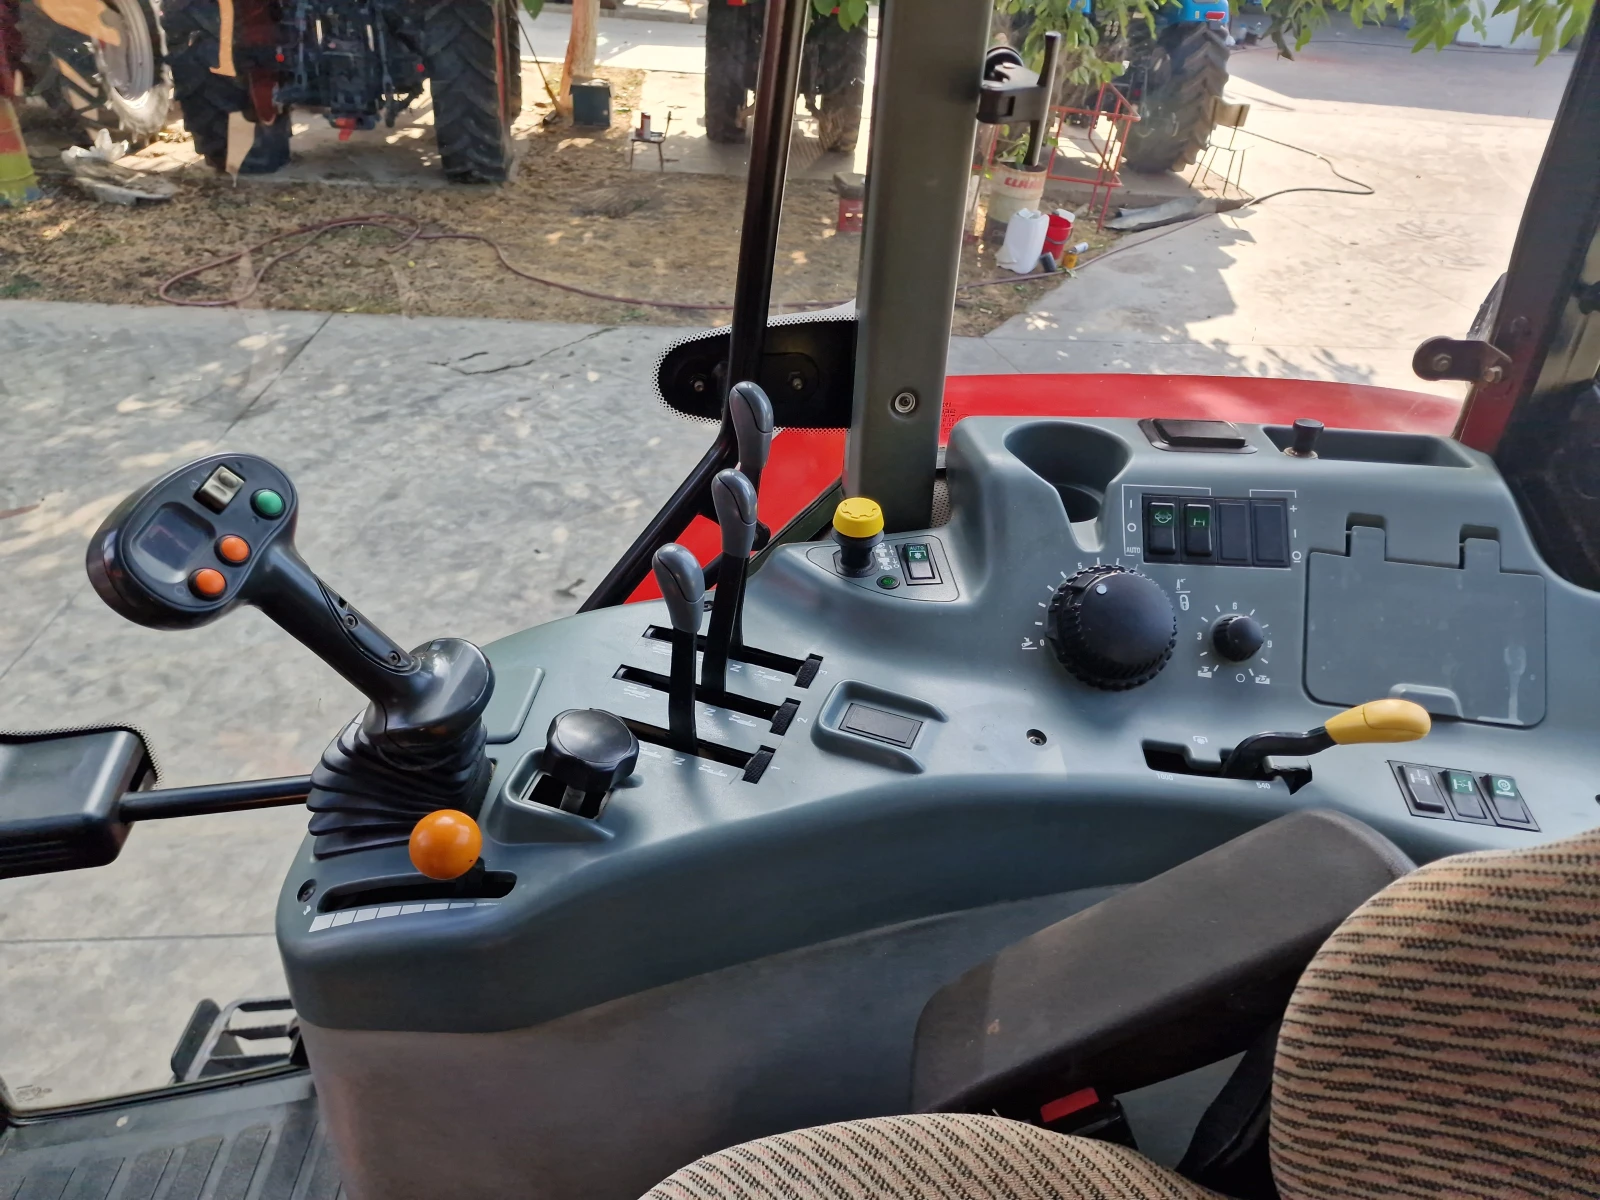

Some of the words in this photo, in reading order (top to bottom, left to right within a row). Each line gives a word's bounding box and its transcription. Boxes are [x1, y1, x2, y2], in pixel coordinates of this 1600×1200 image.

[1077, 562, 1083, 570] 5
[1232, 602, 1238, 610] 6
[1196, 632, 1202, 641] 3
[1039, 639, 1045, 647] 0
[1267, 640, 1273, 648] 9
